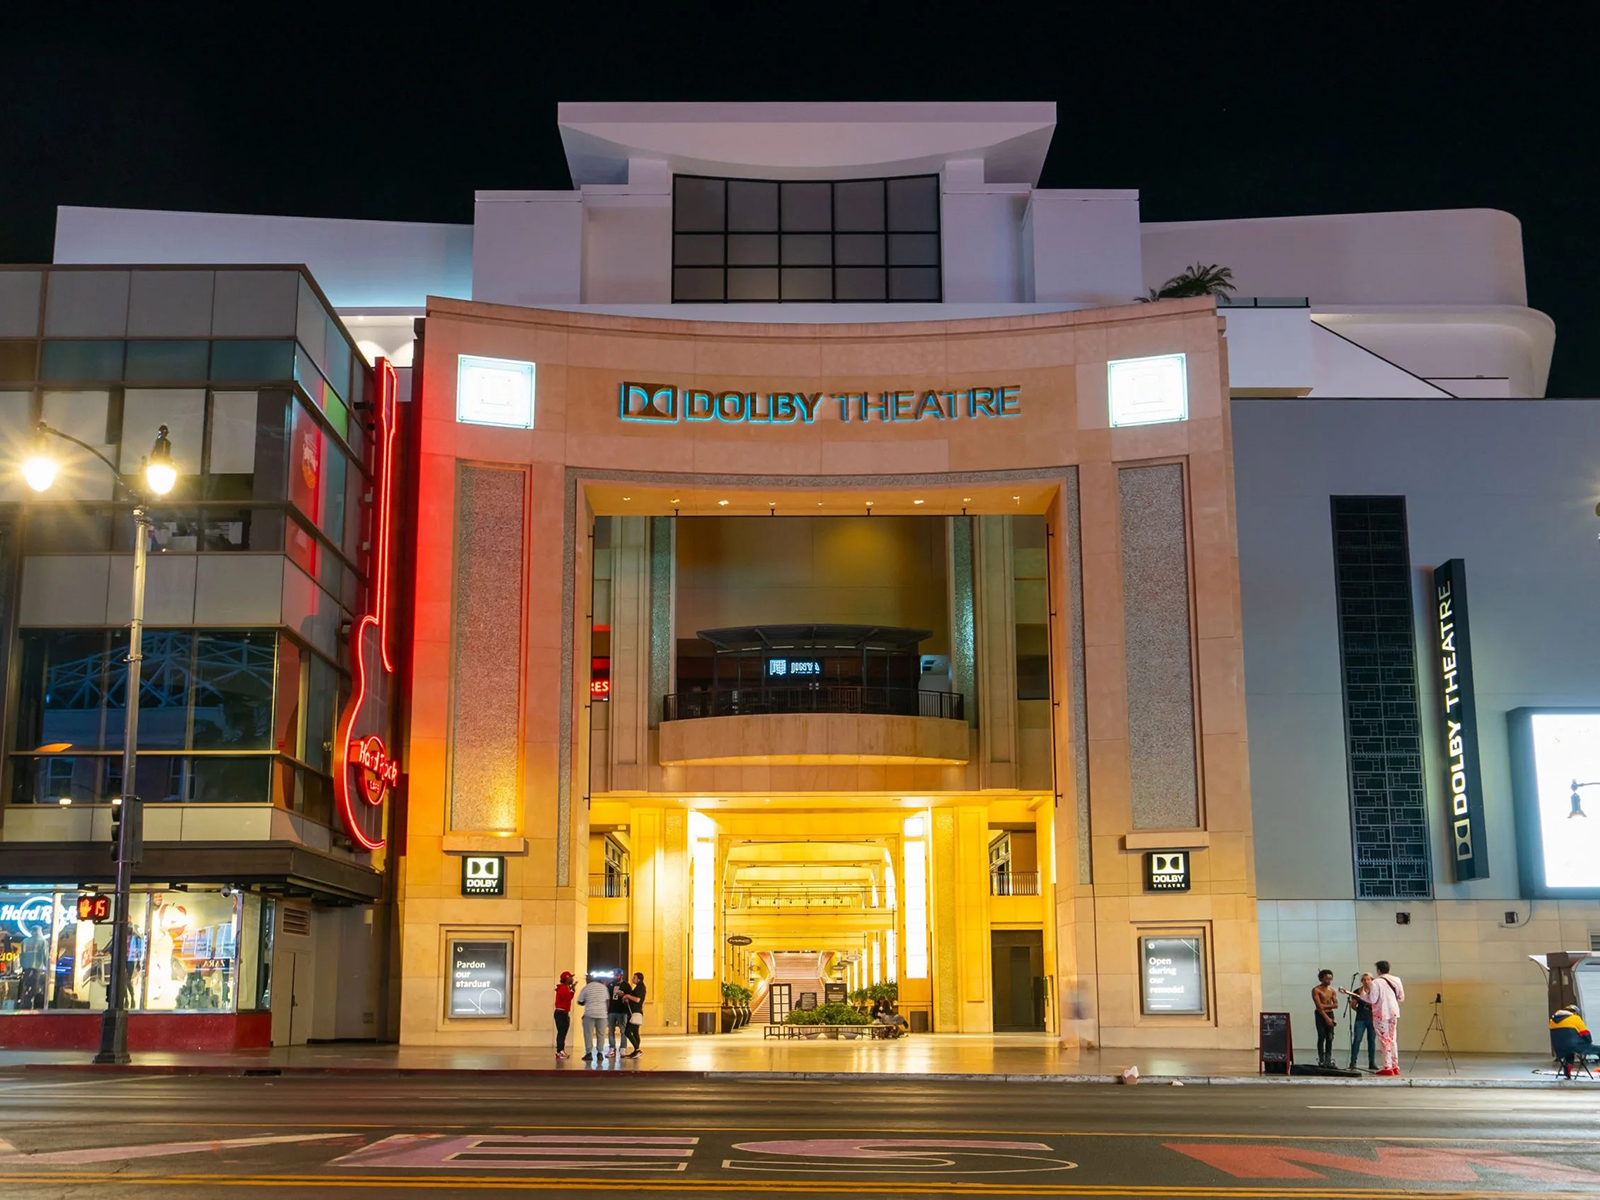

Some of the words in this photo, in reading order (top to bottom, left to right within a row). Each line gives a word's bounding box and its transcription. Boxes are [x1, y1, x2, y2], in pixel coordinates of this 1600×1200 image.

[685, 388, 824, 424] DOLBY
[833, 384, 1022, 424] THEATRE
[1439, 580, 1460, 713] THEATRE
[1448, 720, 1468, 816] DOLBY
[466, 879, 498, 888] DOLBY
[1152, 875, 1184, 883] DOLBY
[95, 899, 107, 917] 15
[1, 905, 41, 921] Hard
[41, 905, 78, 924] Rck
[456, 960, 486, 969] Pardon
[1149, 957, 1172, 967] Open
[455, 971, 471, 979] our
[1148, 967, 1177, 976] during
[455, 980, 491, 988] stardust
